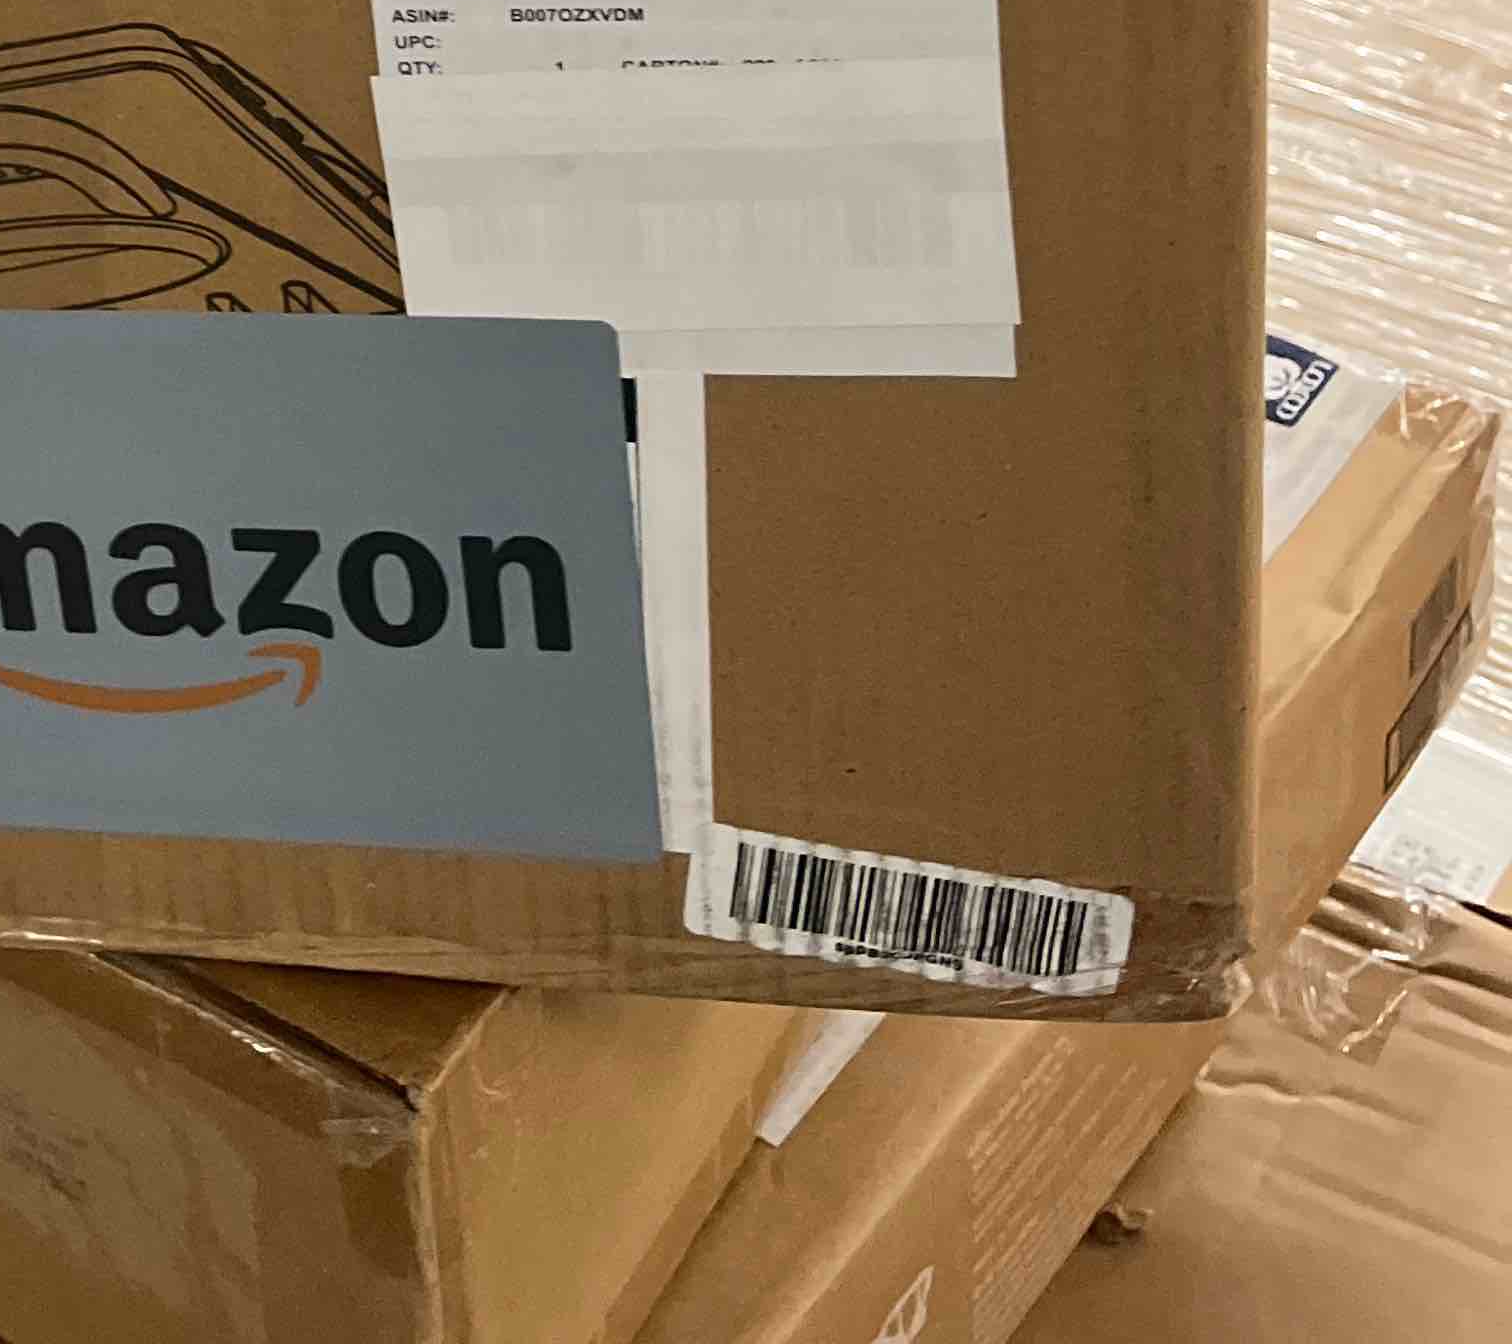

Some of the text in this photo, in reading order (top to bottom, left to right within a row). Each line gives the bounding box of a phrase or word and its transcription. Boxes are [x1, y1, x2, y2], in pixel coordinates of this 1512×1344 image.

[391, 9, 456, 24] ASIN#:
[393, 35, 442, 50] UPC:
[397, 61, 443, 76] QTY:
